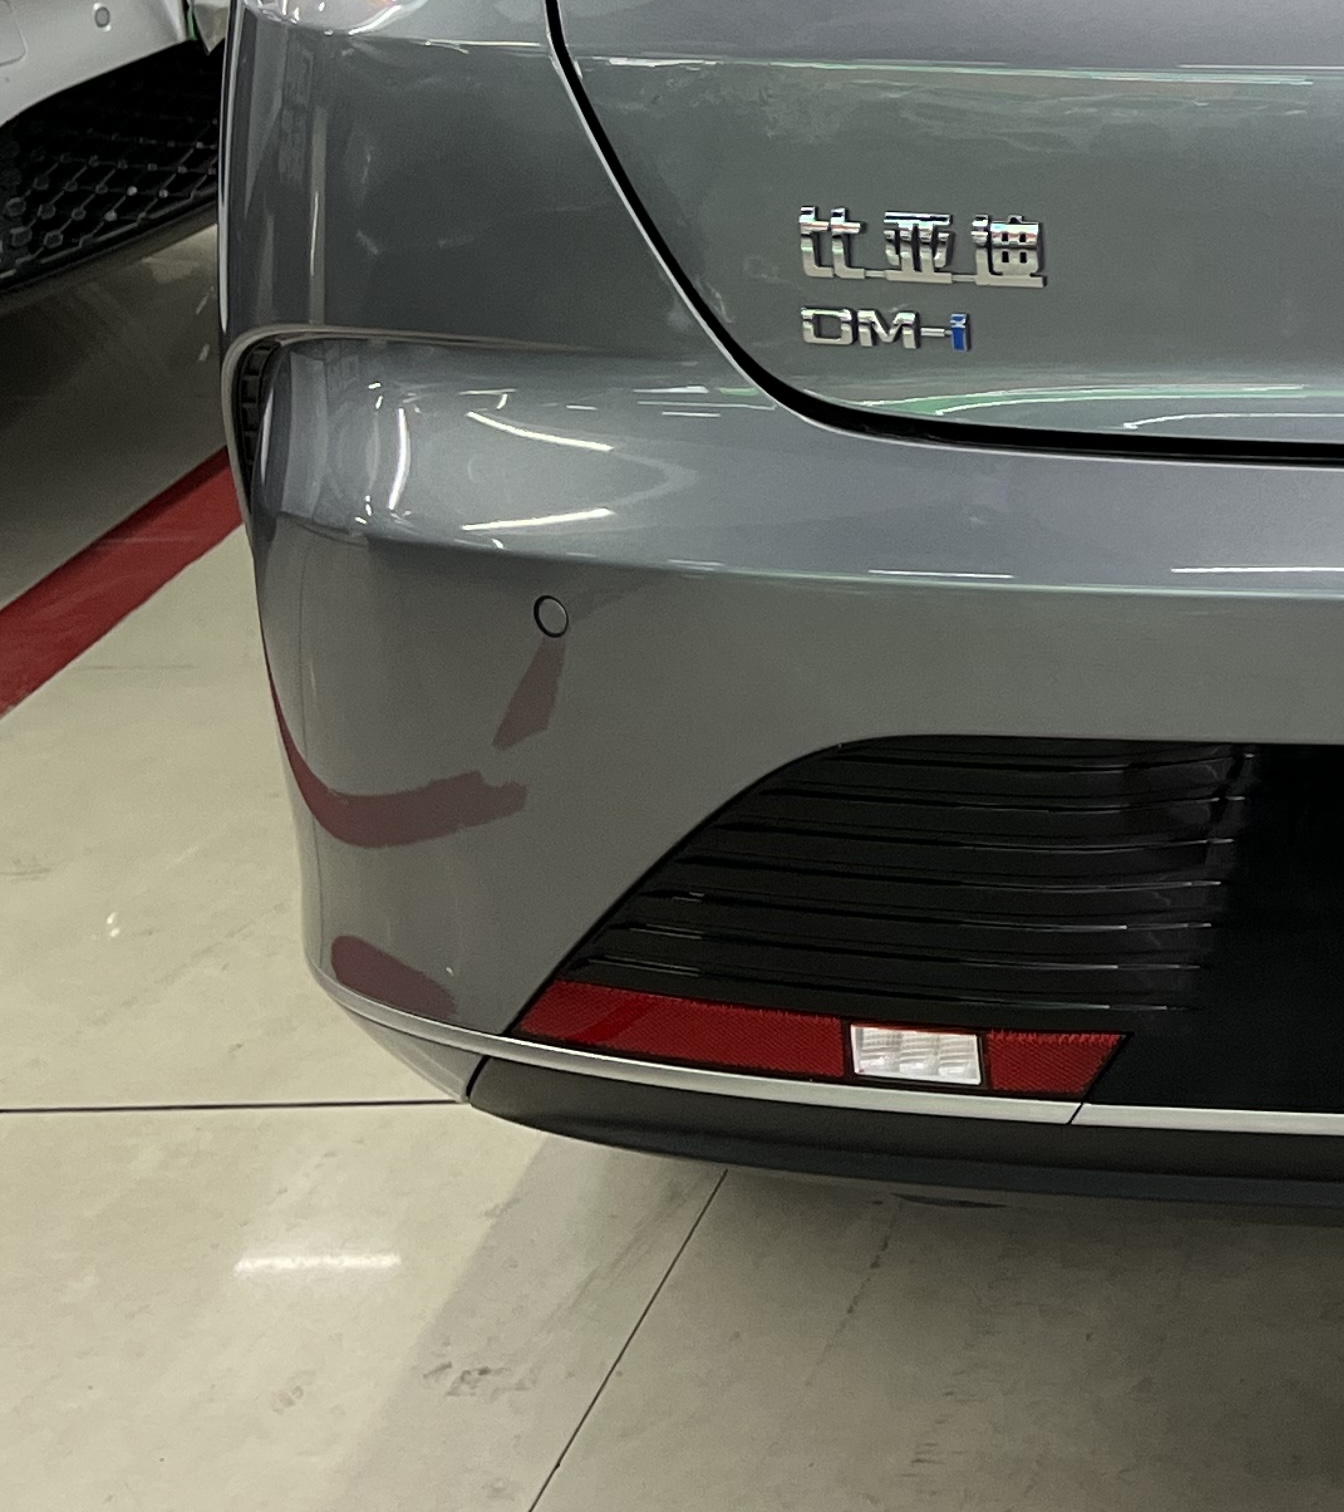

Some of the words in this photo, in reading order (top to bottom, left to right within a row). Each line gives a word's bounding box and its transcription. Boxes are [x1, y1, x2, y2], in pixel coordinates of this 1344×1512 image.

[799, 205, 1047, 288] 比亚迪
[800, 306, 970, 352] DM-i
